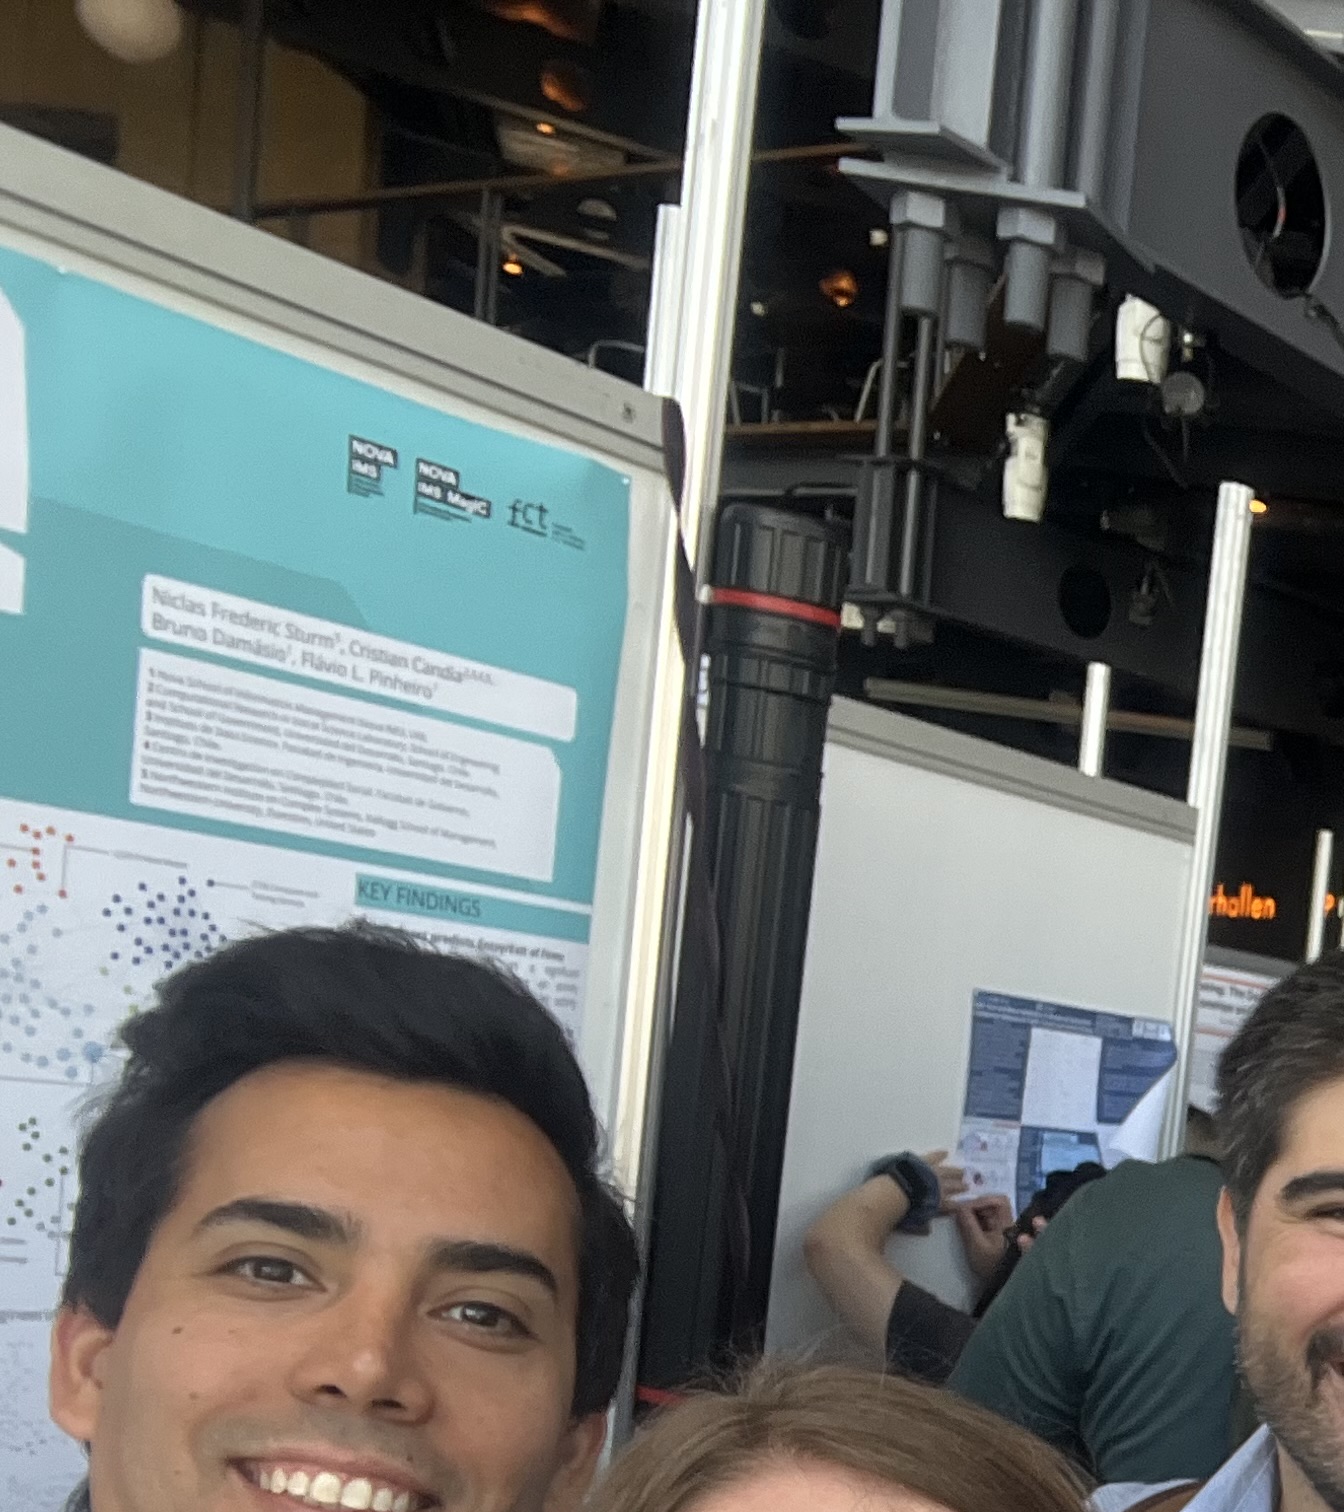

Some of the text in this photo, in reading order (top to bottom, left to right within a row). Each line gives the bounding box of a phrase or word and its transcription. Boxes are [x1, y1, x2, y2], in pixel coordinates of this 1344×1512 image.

[351, 439, 395, 465] NOVA
[351, 459, 378, 479] IMS
[418, 460, 458, 486] NOVA
[416, 481, 442, 500] IMS
[153, 612, 207, 641] Bruno
[358, 878, 481, 918] KEY FINDINGS
